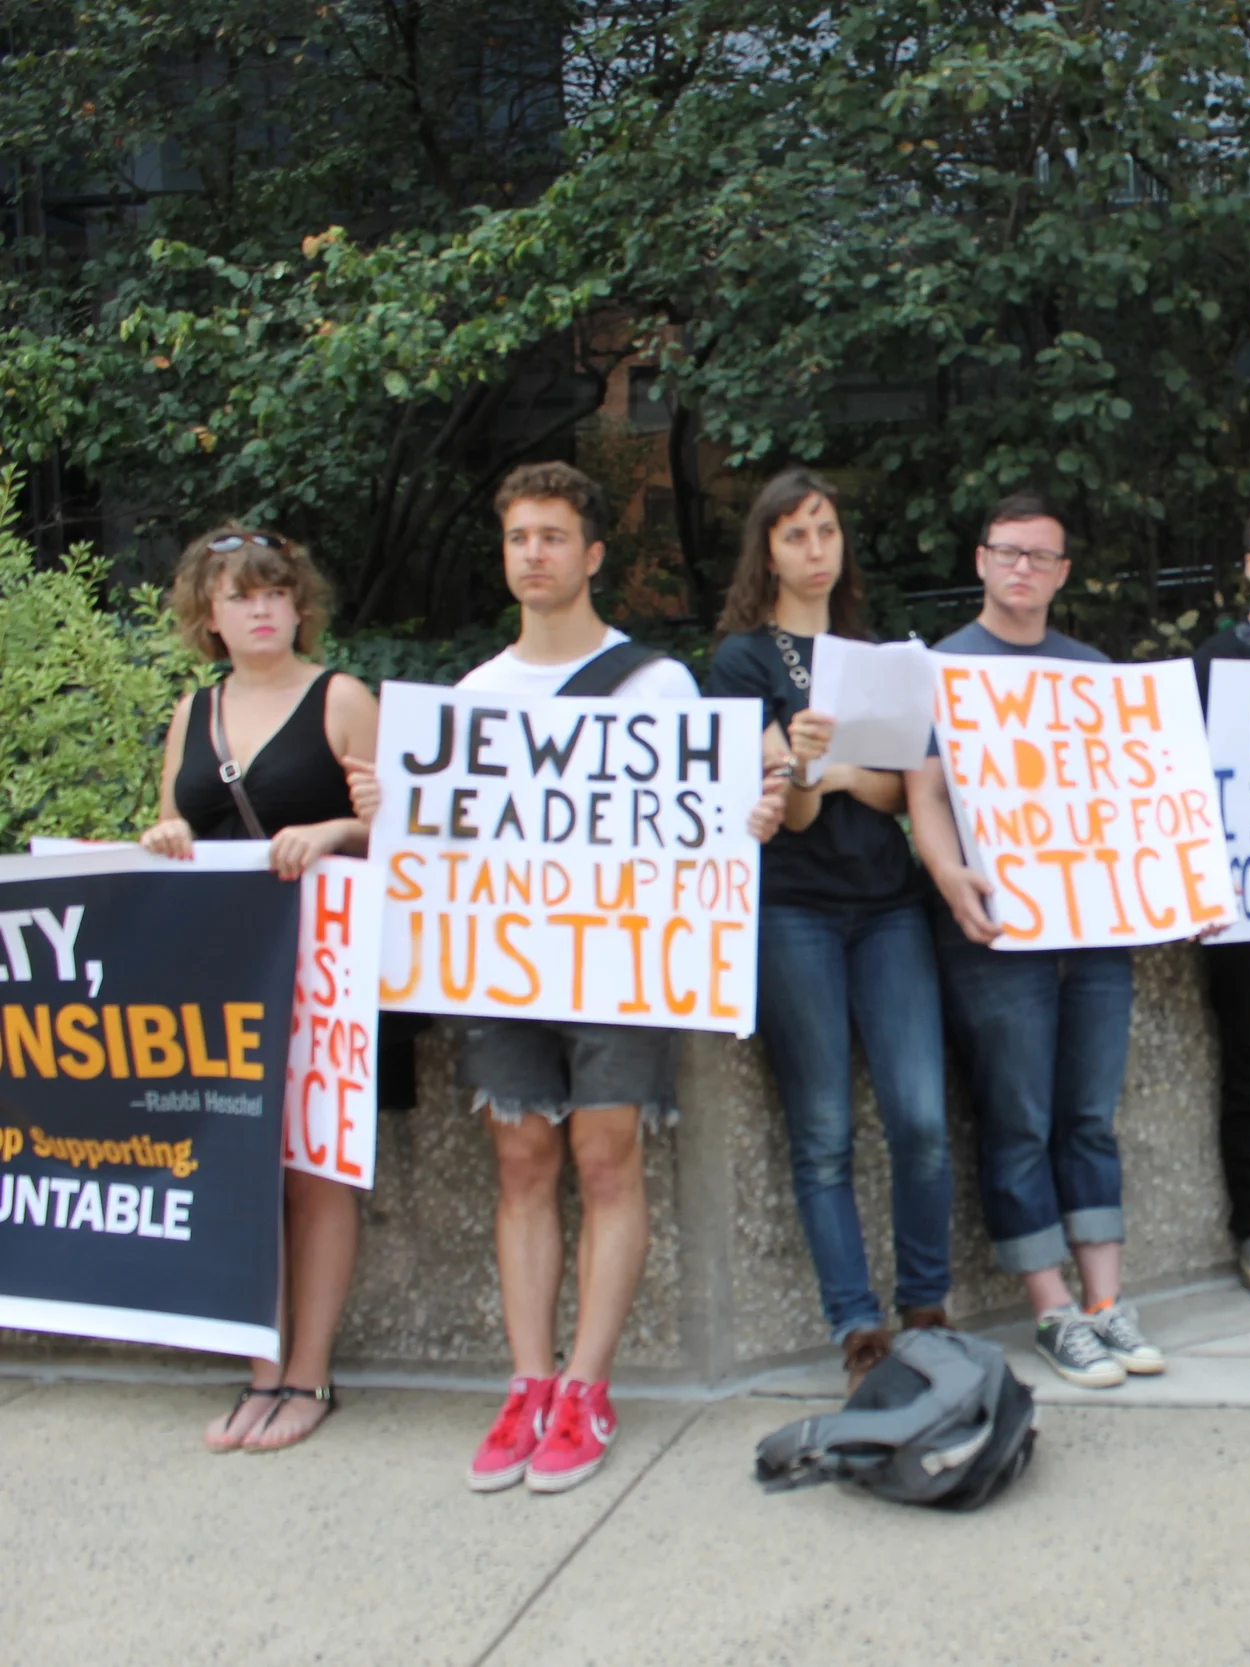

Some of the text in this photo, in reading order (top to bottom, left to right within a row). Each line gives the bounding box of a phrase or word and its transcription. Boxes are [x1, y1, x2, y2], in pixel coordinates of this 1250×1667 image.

[933, 667, 1161, 734] EWISH
[402, 704, 721, 782] JEWISH
[407, 786, 723, 849] LEADERS:
[1066, 797, 1118, 846] UP
[1130, 789, 1213, 842] FOR
[386, 851, 752, 915] STAND UP FOR
[379, 911, 745, 1019] JUSTICE
[0, 1002, 264, 1081] NSIBLE
